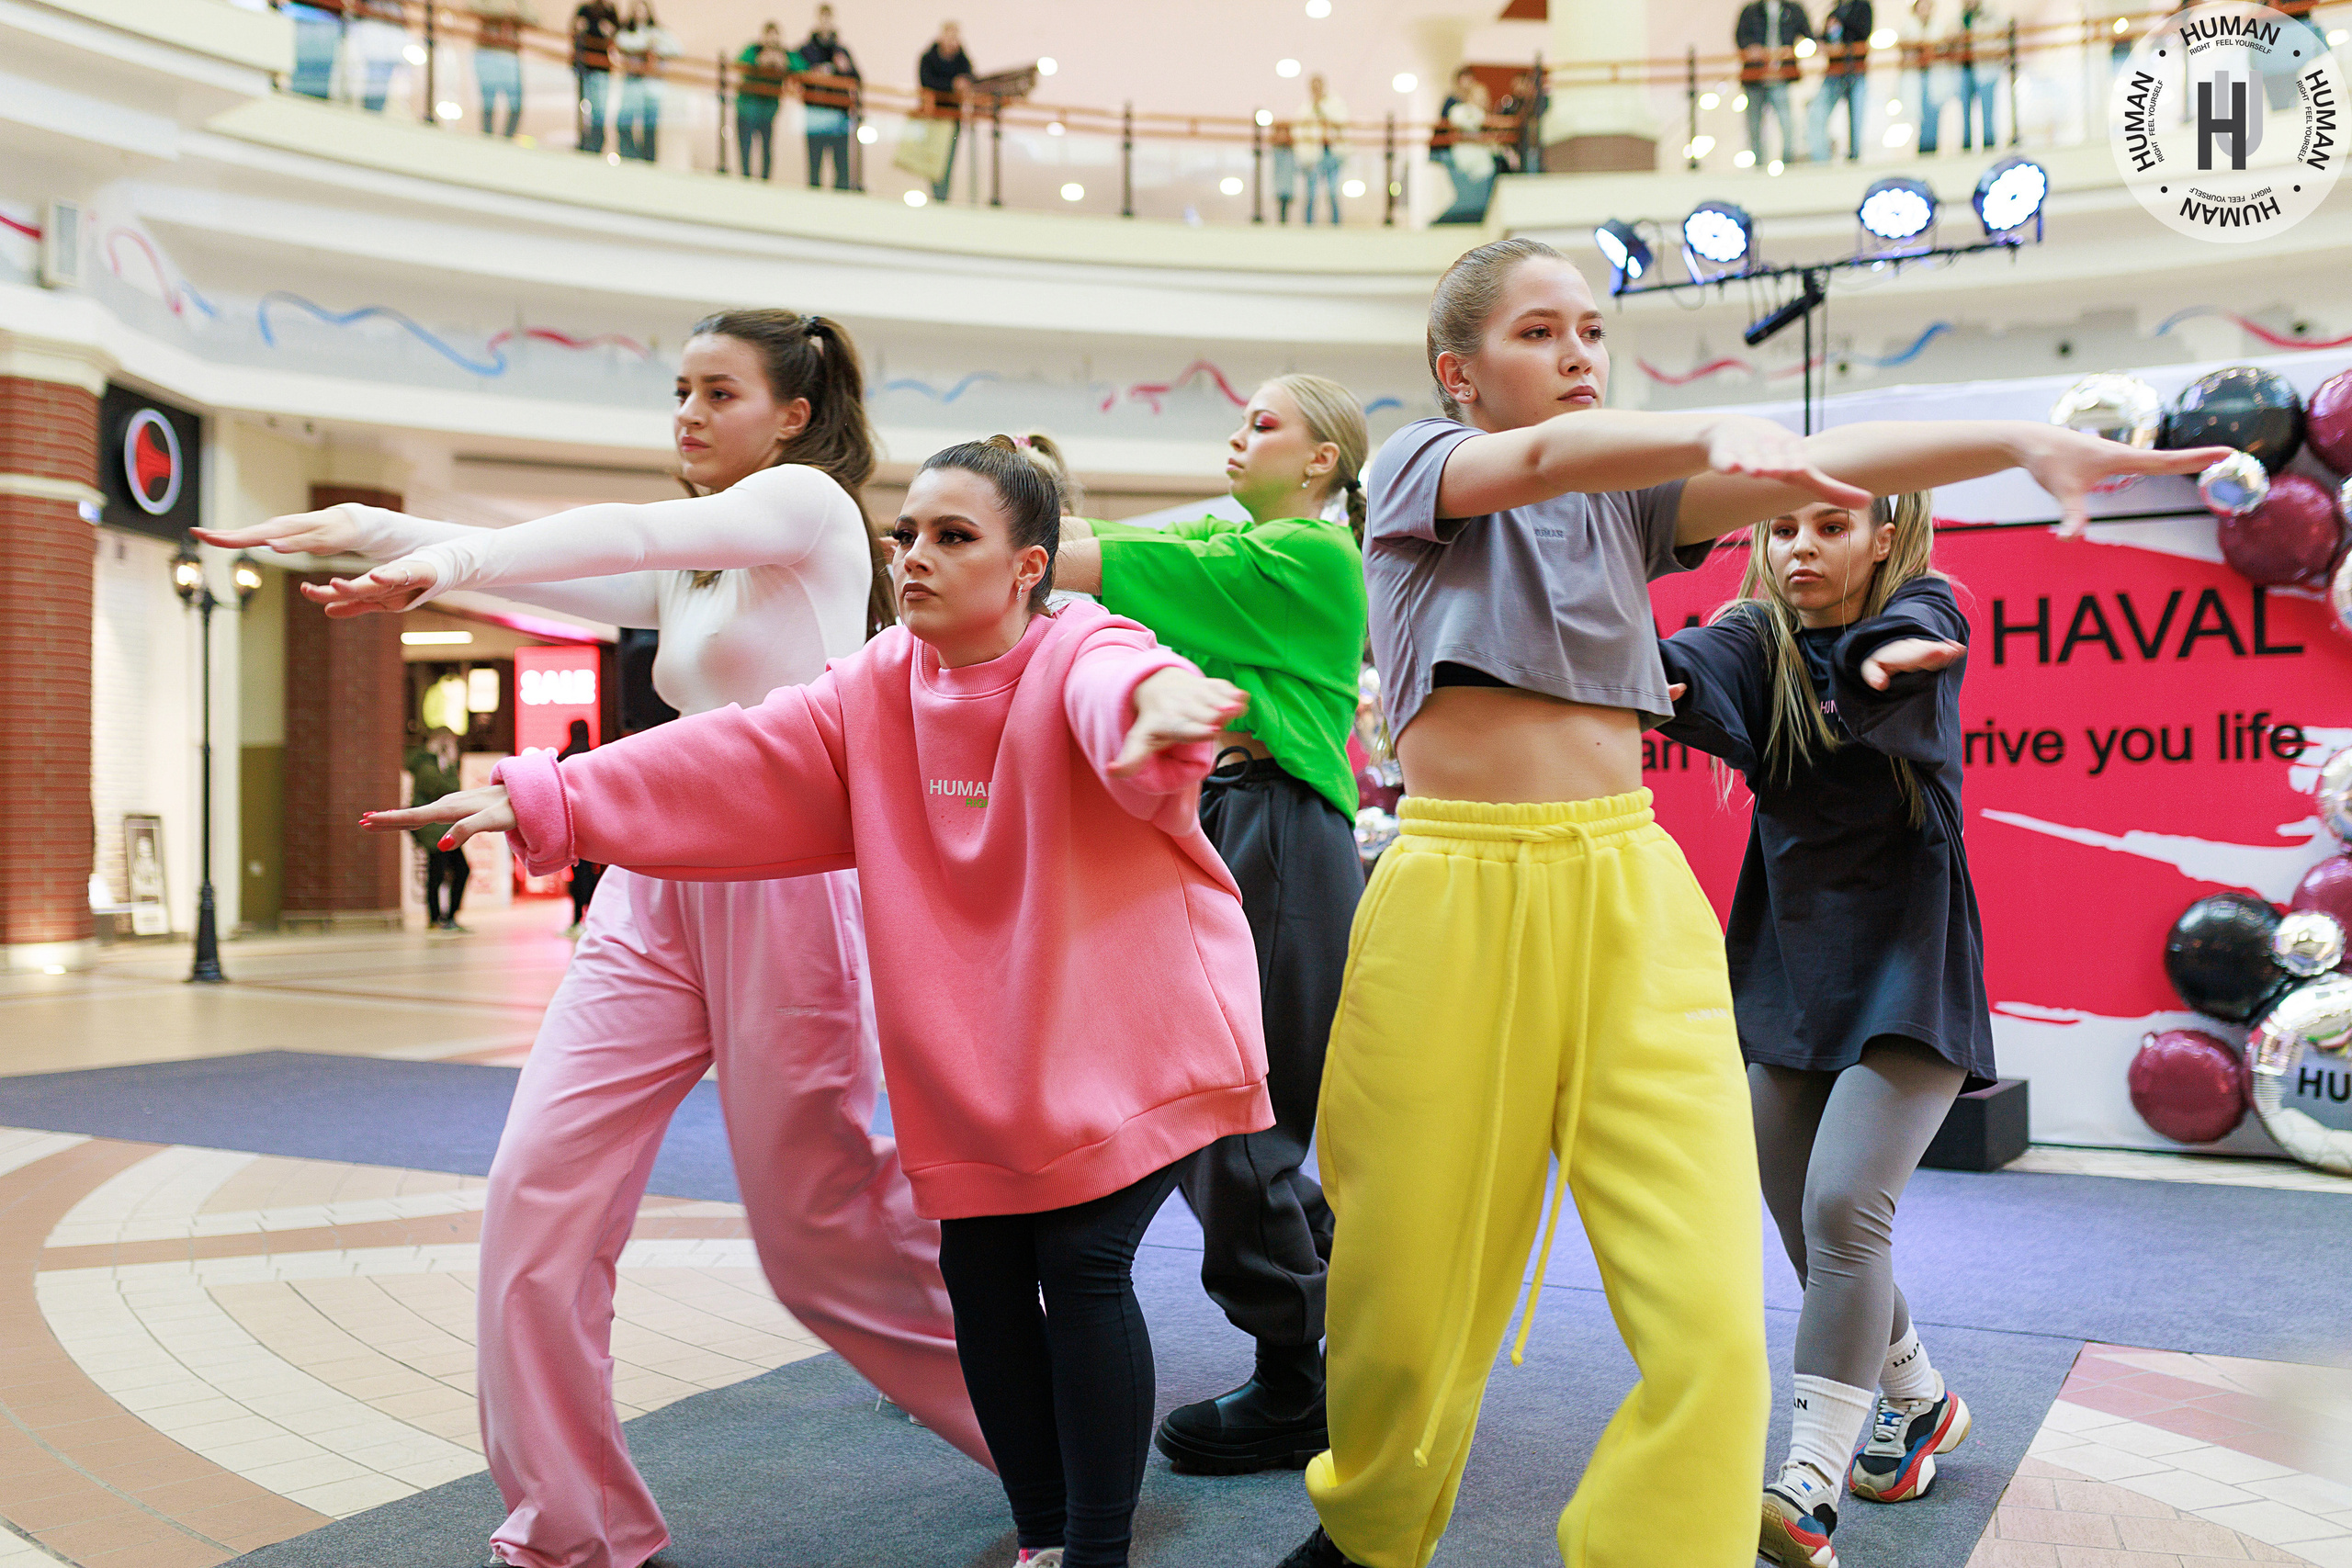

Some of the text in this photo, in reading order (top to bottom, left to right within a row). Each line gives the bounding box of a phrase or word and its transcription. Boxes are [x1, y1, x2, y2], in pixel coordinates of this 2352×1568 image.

[1992, 586, 2305, 665] HAVAL
[2086, 726, 2193, 777] you
[2217, 710, 2307, 761] life
[1892, 1342, 1919, 1368] HU
